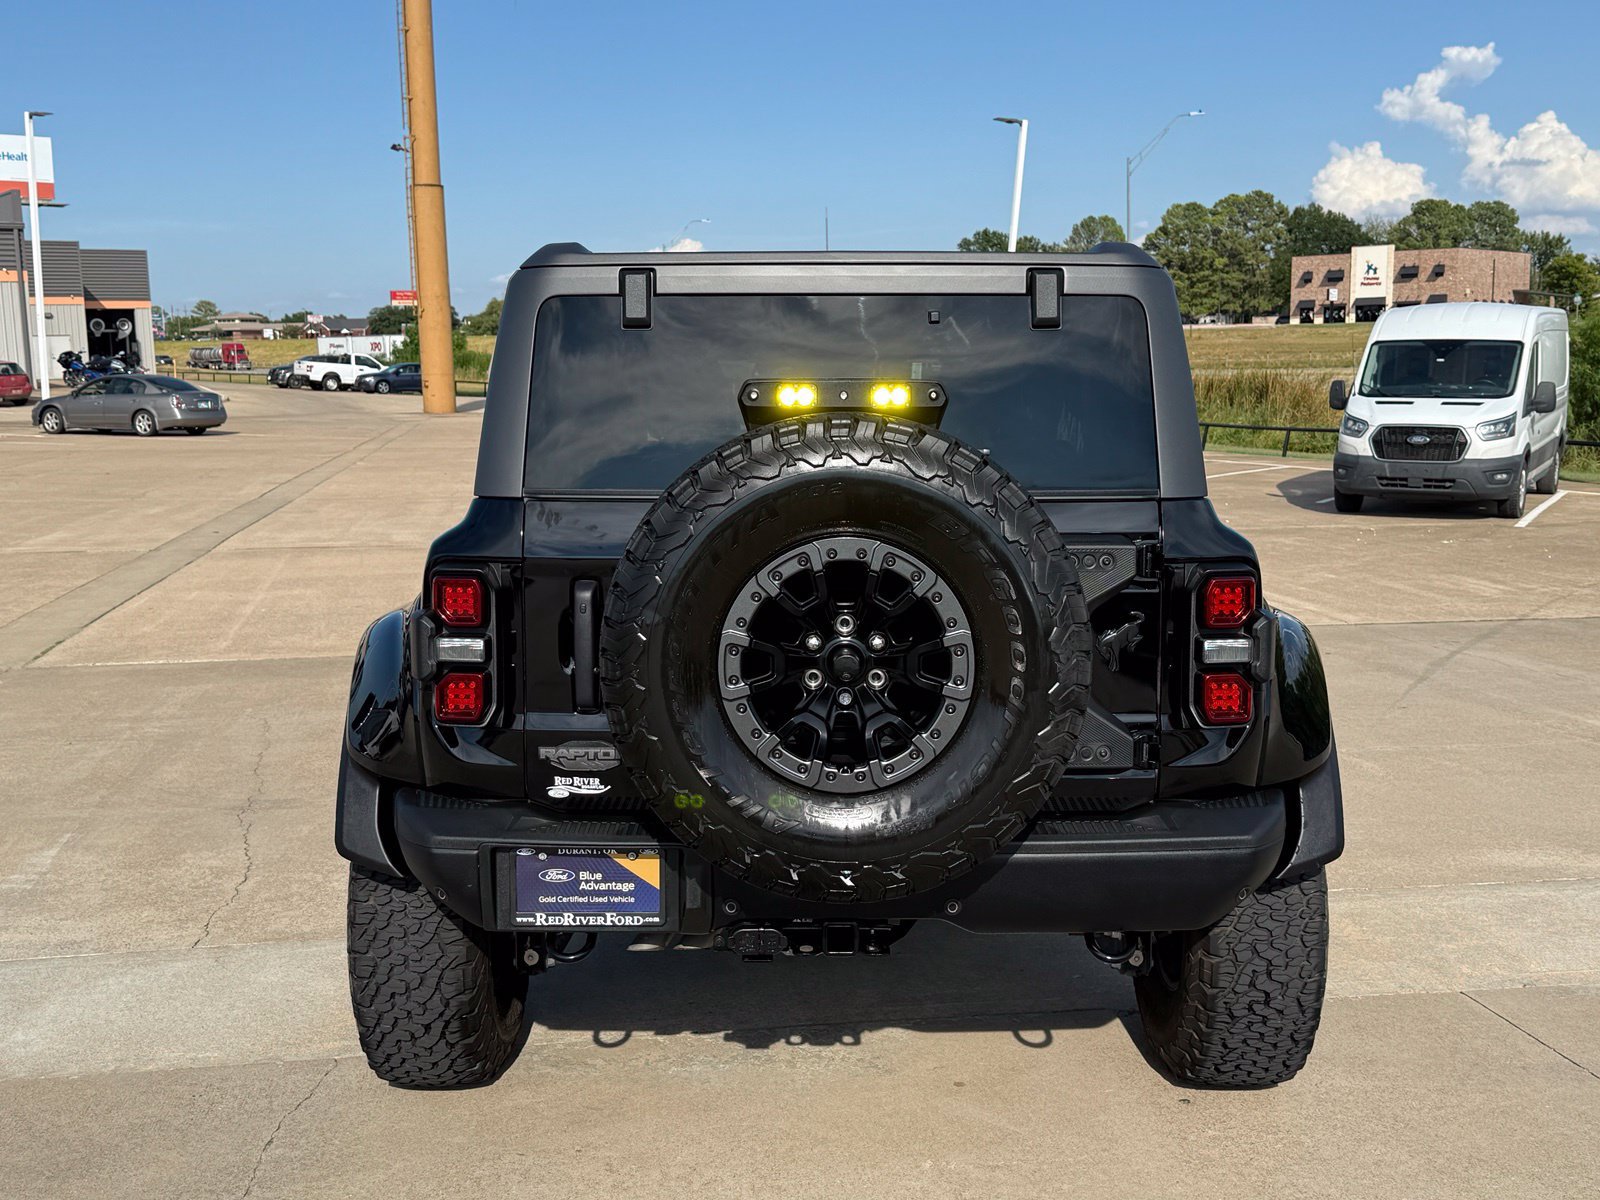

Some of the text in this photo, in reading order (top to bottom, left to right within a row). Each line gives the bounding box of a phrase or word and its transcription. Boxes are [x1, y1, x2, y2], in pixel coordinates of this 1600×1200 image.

[0, 151, 28, 161] Healt
[370, 342, 382, 351] XPO
[538, 747, 620, 761] RAPTO
[554, 776, 600, 786] RED RIVER
[579, 871, 602, 880] Blue
[579, 881, 635, 891] Advantage
